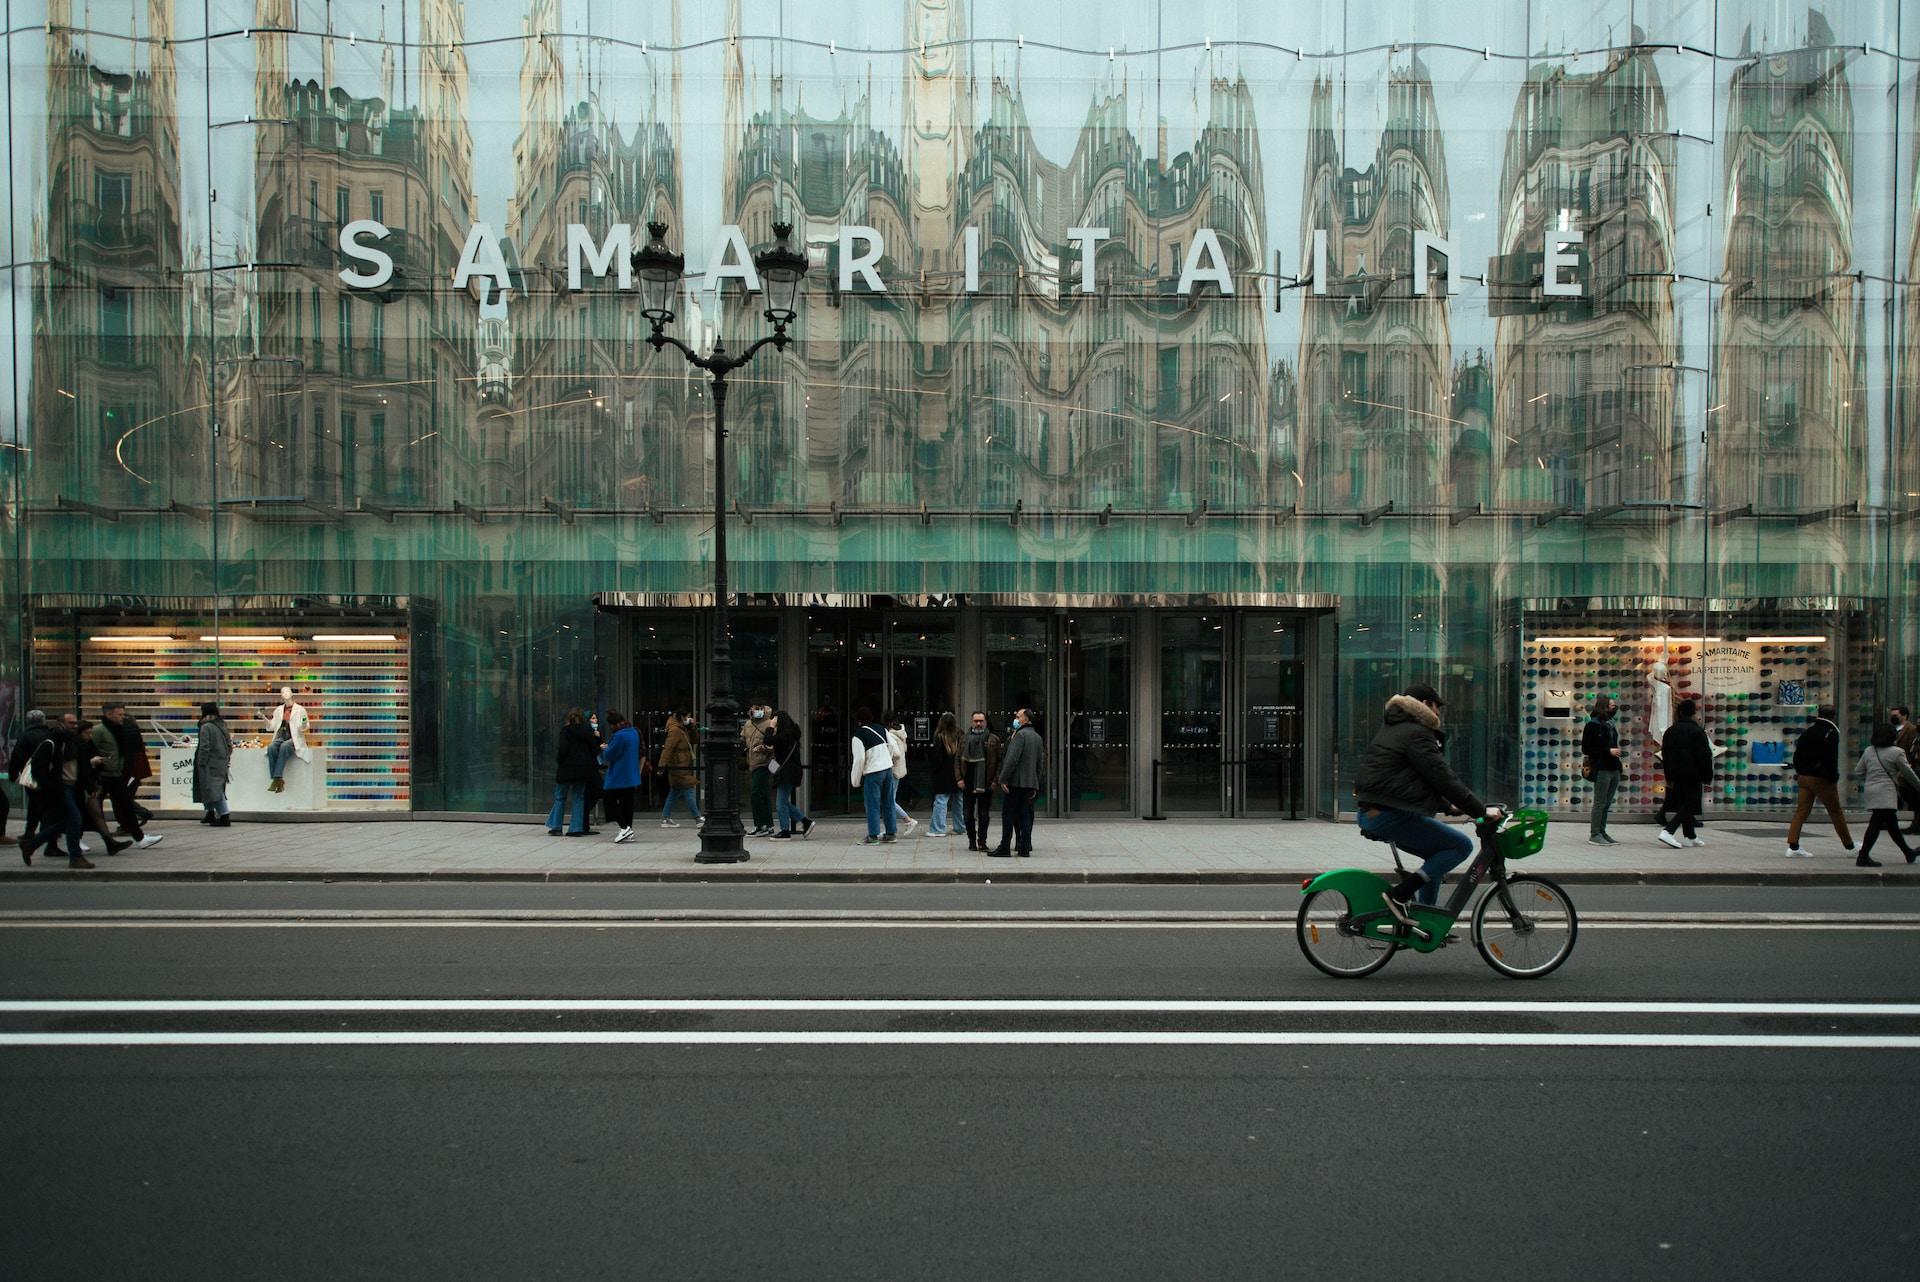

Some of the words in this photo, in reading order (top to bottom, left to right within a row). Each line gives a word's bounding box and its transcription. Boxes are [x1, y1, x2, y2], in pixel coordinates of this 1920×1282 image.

[338, 219, 1584, 297] SAMARITAINE
[1696, 647, 1751, 660] SAMARITAINE
[1733, 665, 1754, 673] MAIN
[171, 777, 182, 785] LE
